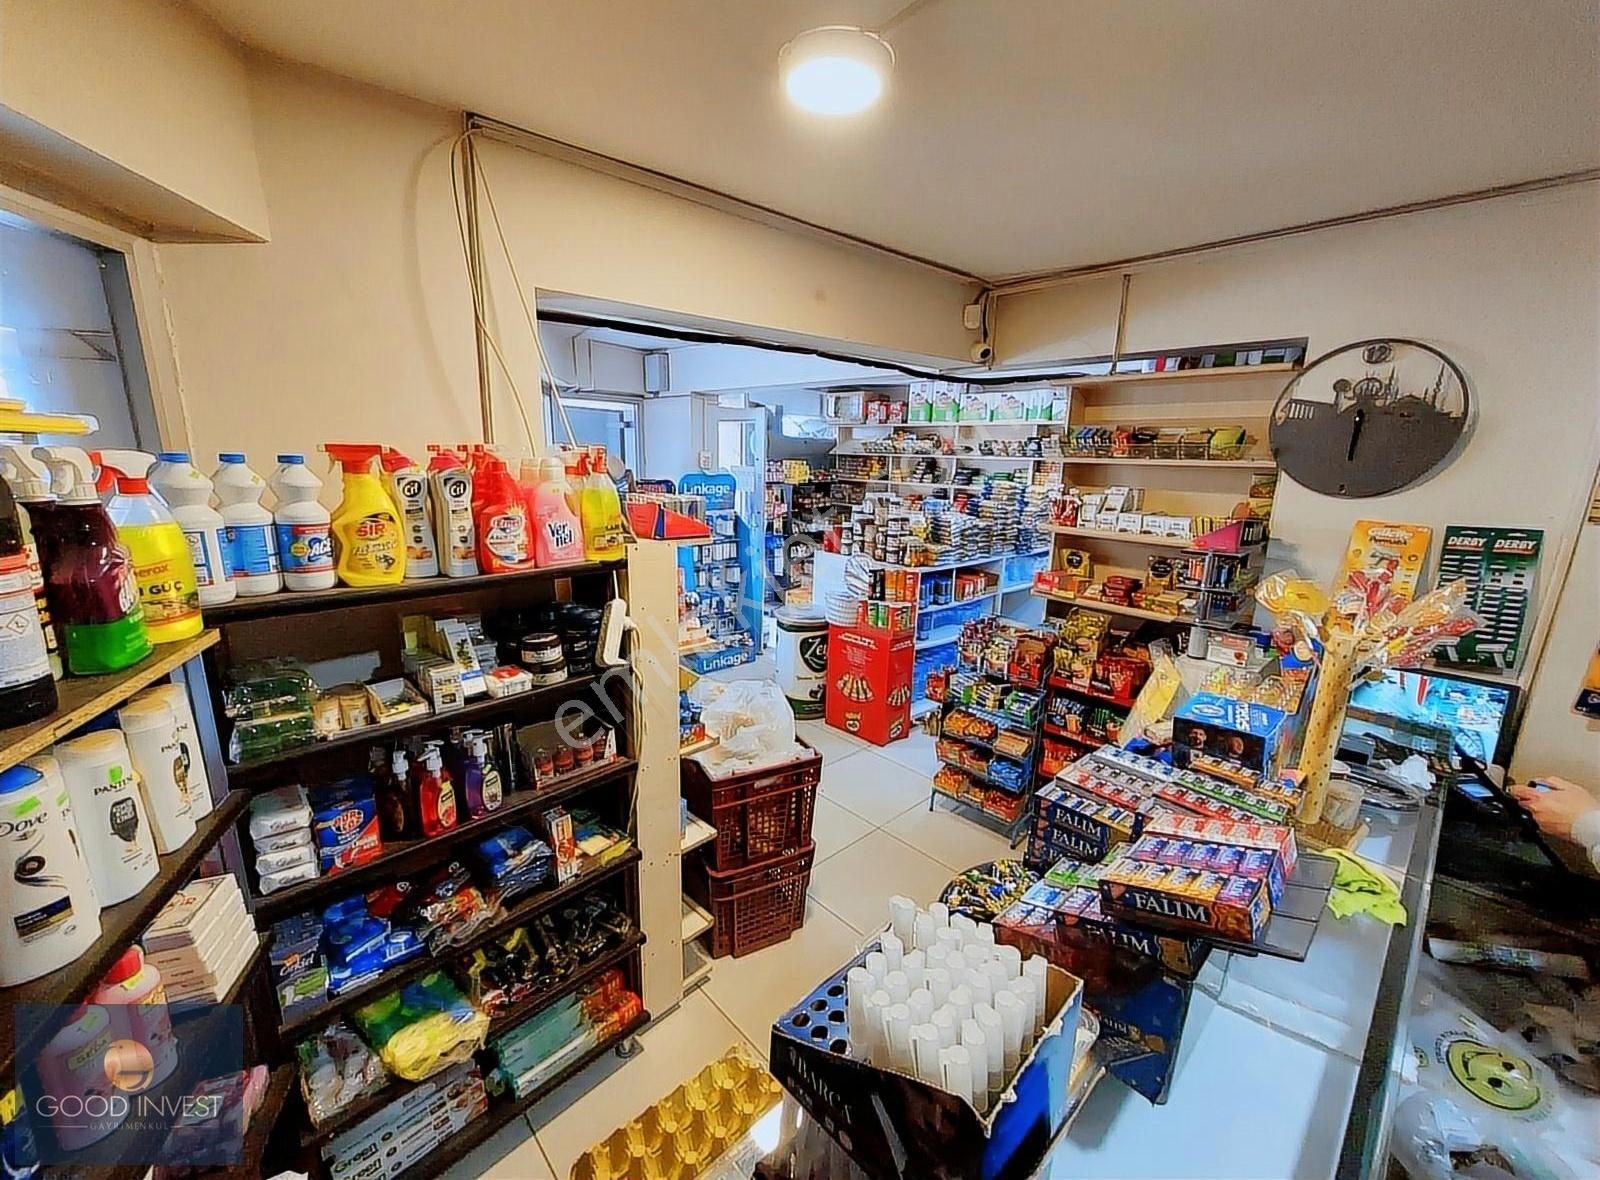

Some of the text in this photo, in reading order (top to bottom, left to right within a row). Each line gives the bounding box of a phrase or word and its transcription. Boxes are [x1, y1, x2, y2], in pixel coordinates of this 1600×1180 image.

[683, 483, 730, 496] Linkage
[1447, 536, 1487, 547] DERBY
[1494, 539, 1537, 550] DERBY
[703, 651, 749, 671] Linkage
[0, 811, 48, 838] Dove
[1056, 808, 1101, 837] FALIM
[1053, 828, 1098, 857] FALIM
[1133, 892, 1208, 922] FALIM
